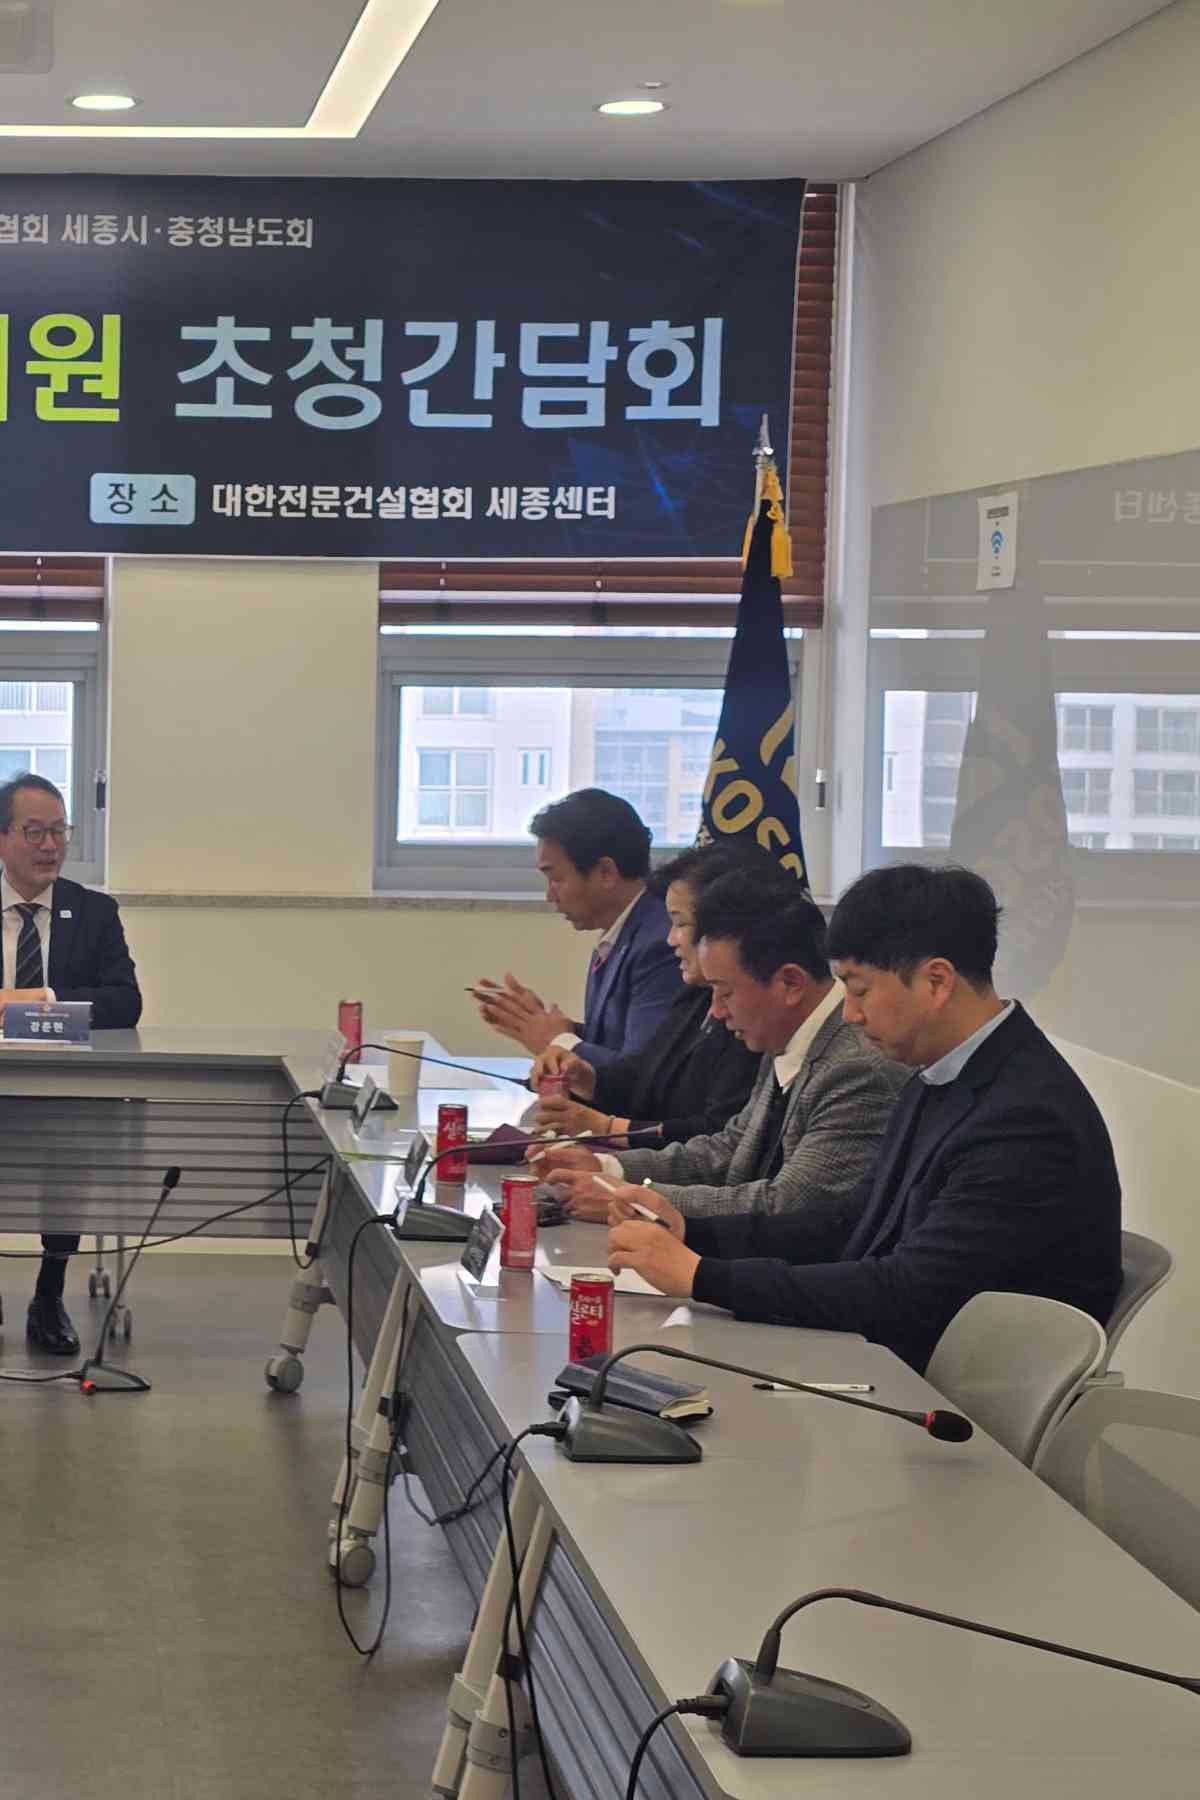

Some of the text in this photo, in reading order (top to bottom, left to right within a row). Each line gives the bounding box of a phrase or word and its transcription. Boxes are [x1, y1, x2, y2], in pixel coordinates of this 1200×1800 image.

[175, 316, 724, 430] 초청간담회
[212, 484, 616, 521] 대한전문건설협회 세종센터
